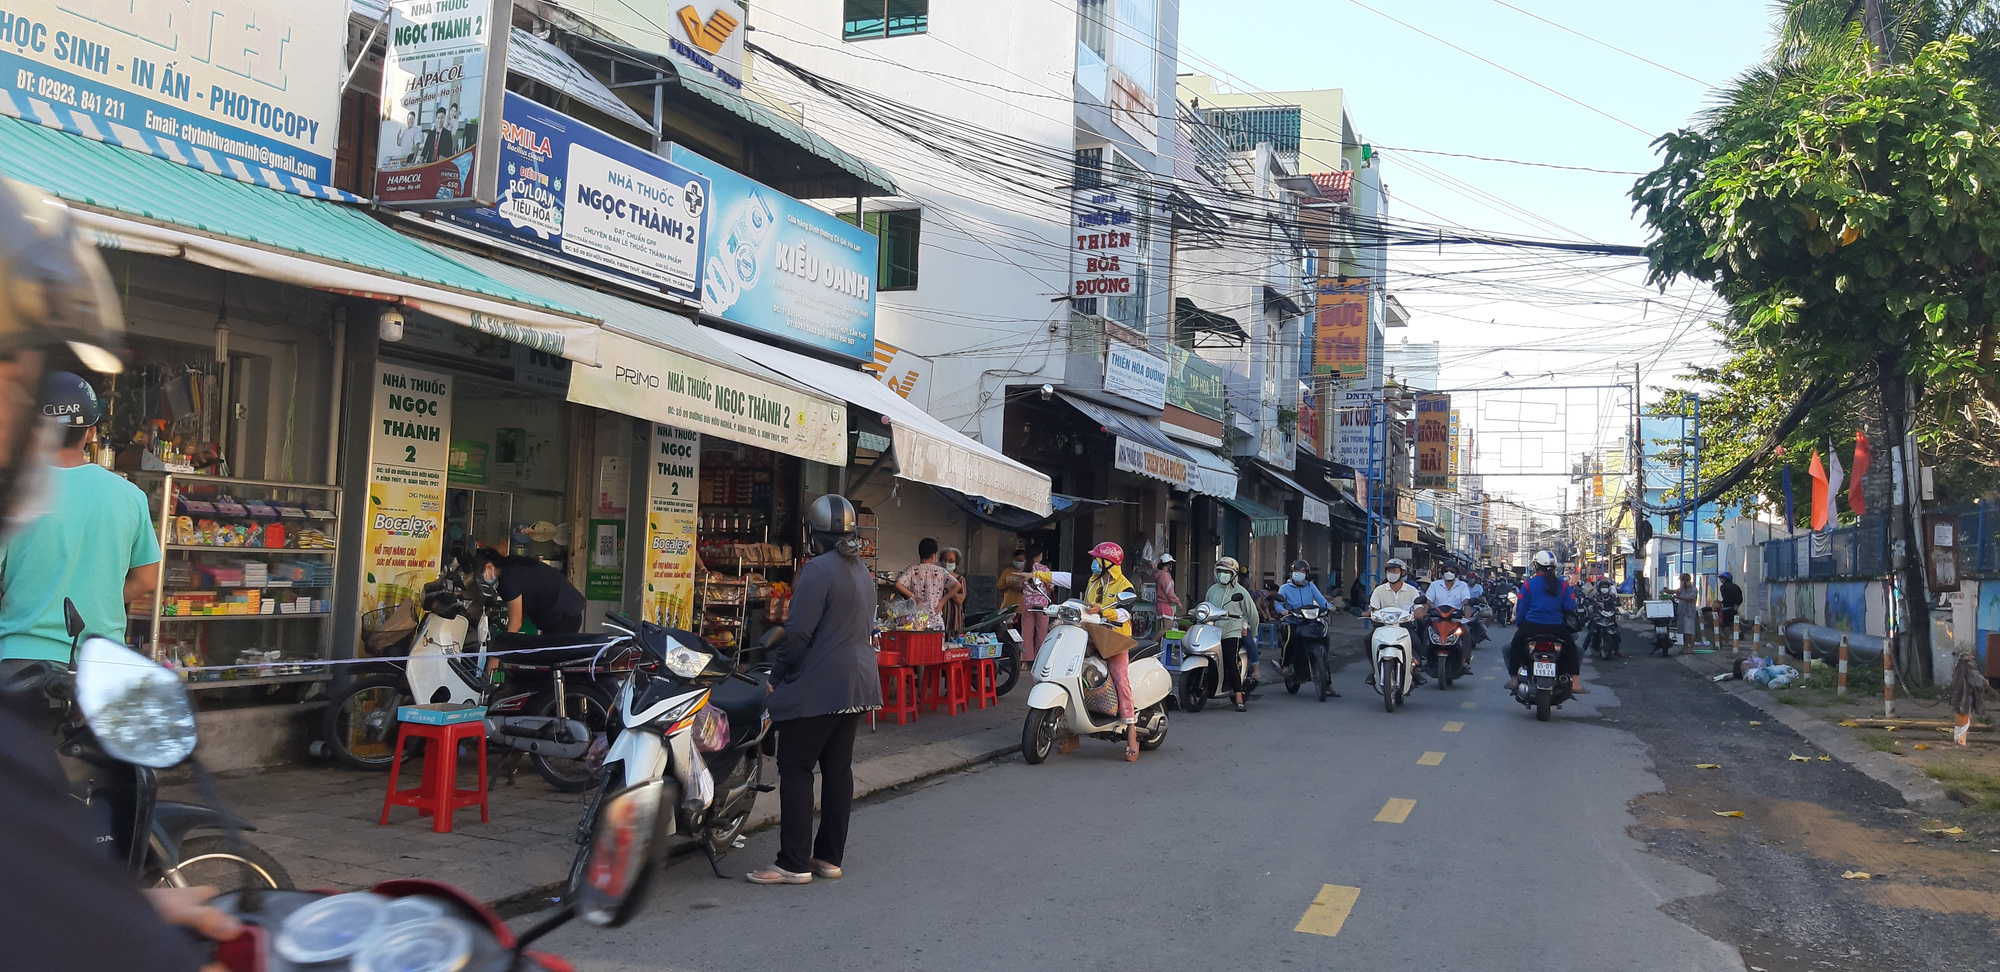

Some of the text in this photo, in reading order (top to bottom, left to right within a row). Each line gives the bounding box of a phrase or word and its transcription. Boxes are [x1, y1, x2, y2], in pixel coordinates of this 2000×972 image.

[394, 15, 482, 49] NGỌC THÀNH 2
[0, 10, 320, 145] HỌC SINH IN ẤN PHOTOCOPY
[405, 64, 465, 92] HAPACOL
[17, 68, 125, 120] ĐT: 02923. 841 211
[145, 109, 179, 138] Email:
[507, 142, 528, 158] Bacillus
[387, 173, 421, 184] HAPACOL
[608, 170, 675, 208] NHÀ THUỐC
[512, 199, 531, 216] TIÊU
[529, 186, 556, 209] LOẠN
[578, 184, 695, 245] NGỌC THÀNH 2
[584, 227, 607, 240] CHUYÊN
[608, 233, 620, 243] BÁN
[629, 241, 648, 253] THUỐC
[649, 248, 667, 260] THÀNH
[667, 253, 682, 265] PHẨM
[627, 231, 645, 243] CHUẨN
[646, 238, 657, 247] GPP
[1077, 229, 1131, 250] THIÊN
[775, 238, 819, 281] KIỀU
[823, 261, 869, 301] OANH
[1087, 251, 1120, 272] HÒA
[1076, 273, 1131, 296] ĐƯỜNG
[1321, 298, 1363, 327] ĐỨC
[1323, 332, 1361, 360] TÍN
[1111, 353, 1130, 371] THIÊN
[1131, 357, 1144, 377] HÒA
[1145, 366, 1165, 384] ĐƯỜNG
[382, 372, 446, 396] NHÀ THUỐC
[1211, 374, 1221, 399] 17
[43, 403, 80, 415] CLEAR
[389, 394, 437, 418] NGỌC
[667, 370, 791, 429] NHÀ THUỐC NGỌC THÀNH 2
[676, 406, 682, 416] SỐ
[683, 410, 688, 418] 09
[383, 417, 441, 442] THÀNH
[657, 425, 672, 439] NHÀ
[405, 445, 416, 463] 2
[661, 442, 691, 461] NGỌC
[657, 462, 693, 478] THÀNH
[671, 482, 679, 496] 2
[374, 513, 432, 532] Bocalex
[411, 531, 430, 539] Multi
[652, 537, 690, 551] Bocalex
[374, 543, 382, 555] HỖ
[382, 546, 392, 557] TRỢ
[407, 547, 417, 556] CAO
